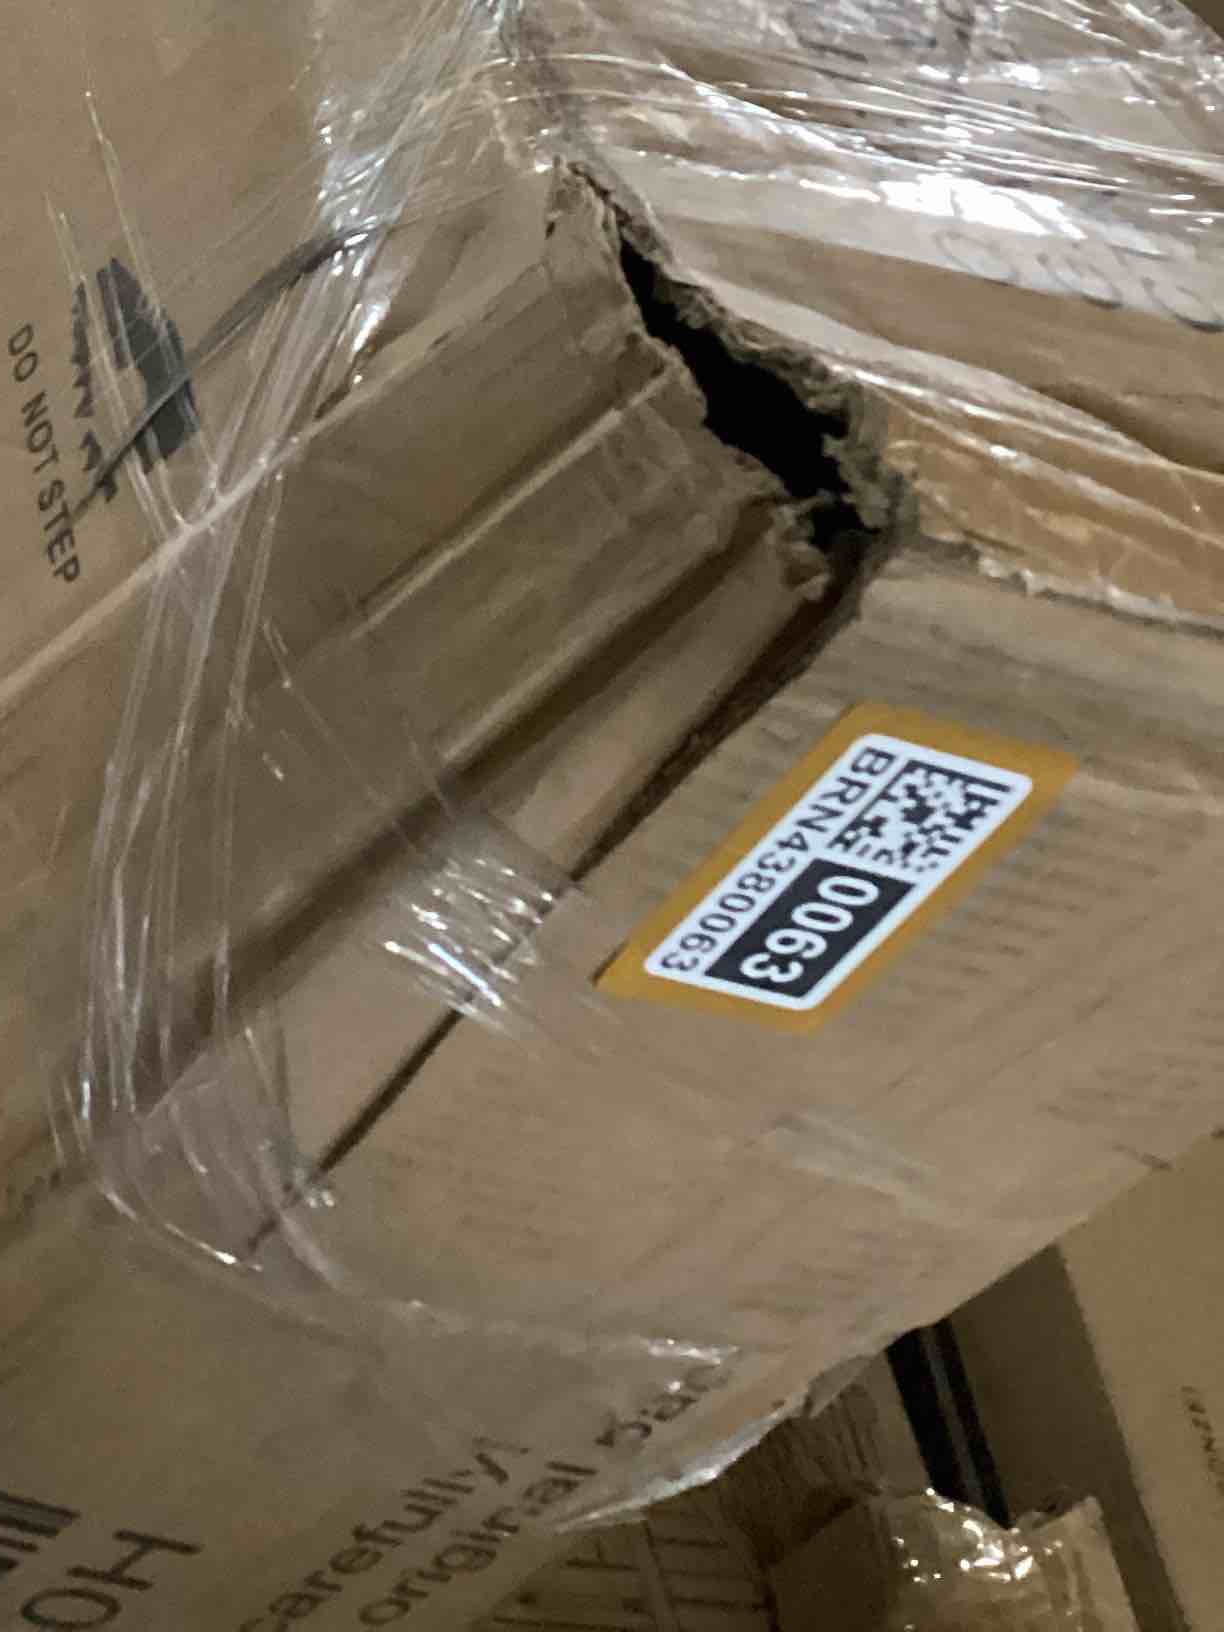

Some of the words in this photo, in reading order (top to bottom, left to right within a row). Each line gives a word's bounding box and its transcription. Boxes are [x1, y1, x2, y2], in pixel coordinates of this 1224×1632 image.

[8, 323, 39, 383] DO
[21, 389, 59, 474] NOT
[37, 478, 81, 584] STEP
[661, 747, 896, 972] BRN4380063
[740, 875, 880, 984] 0063
